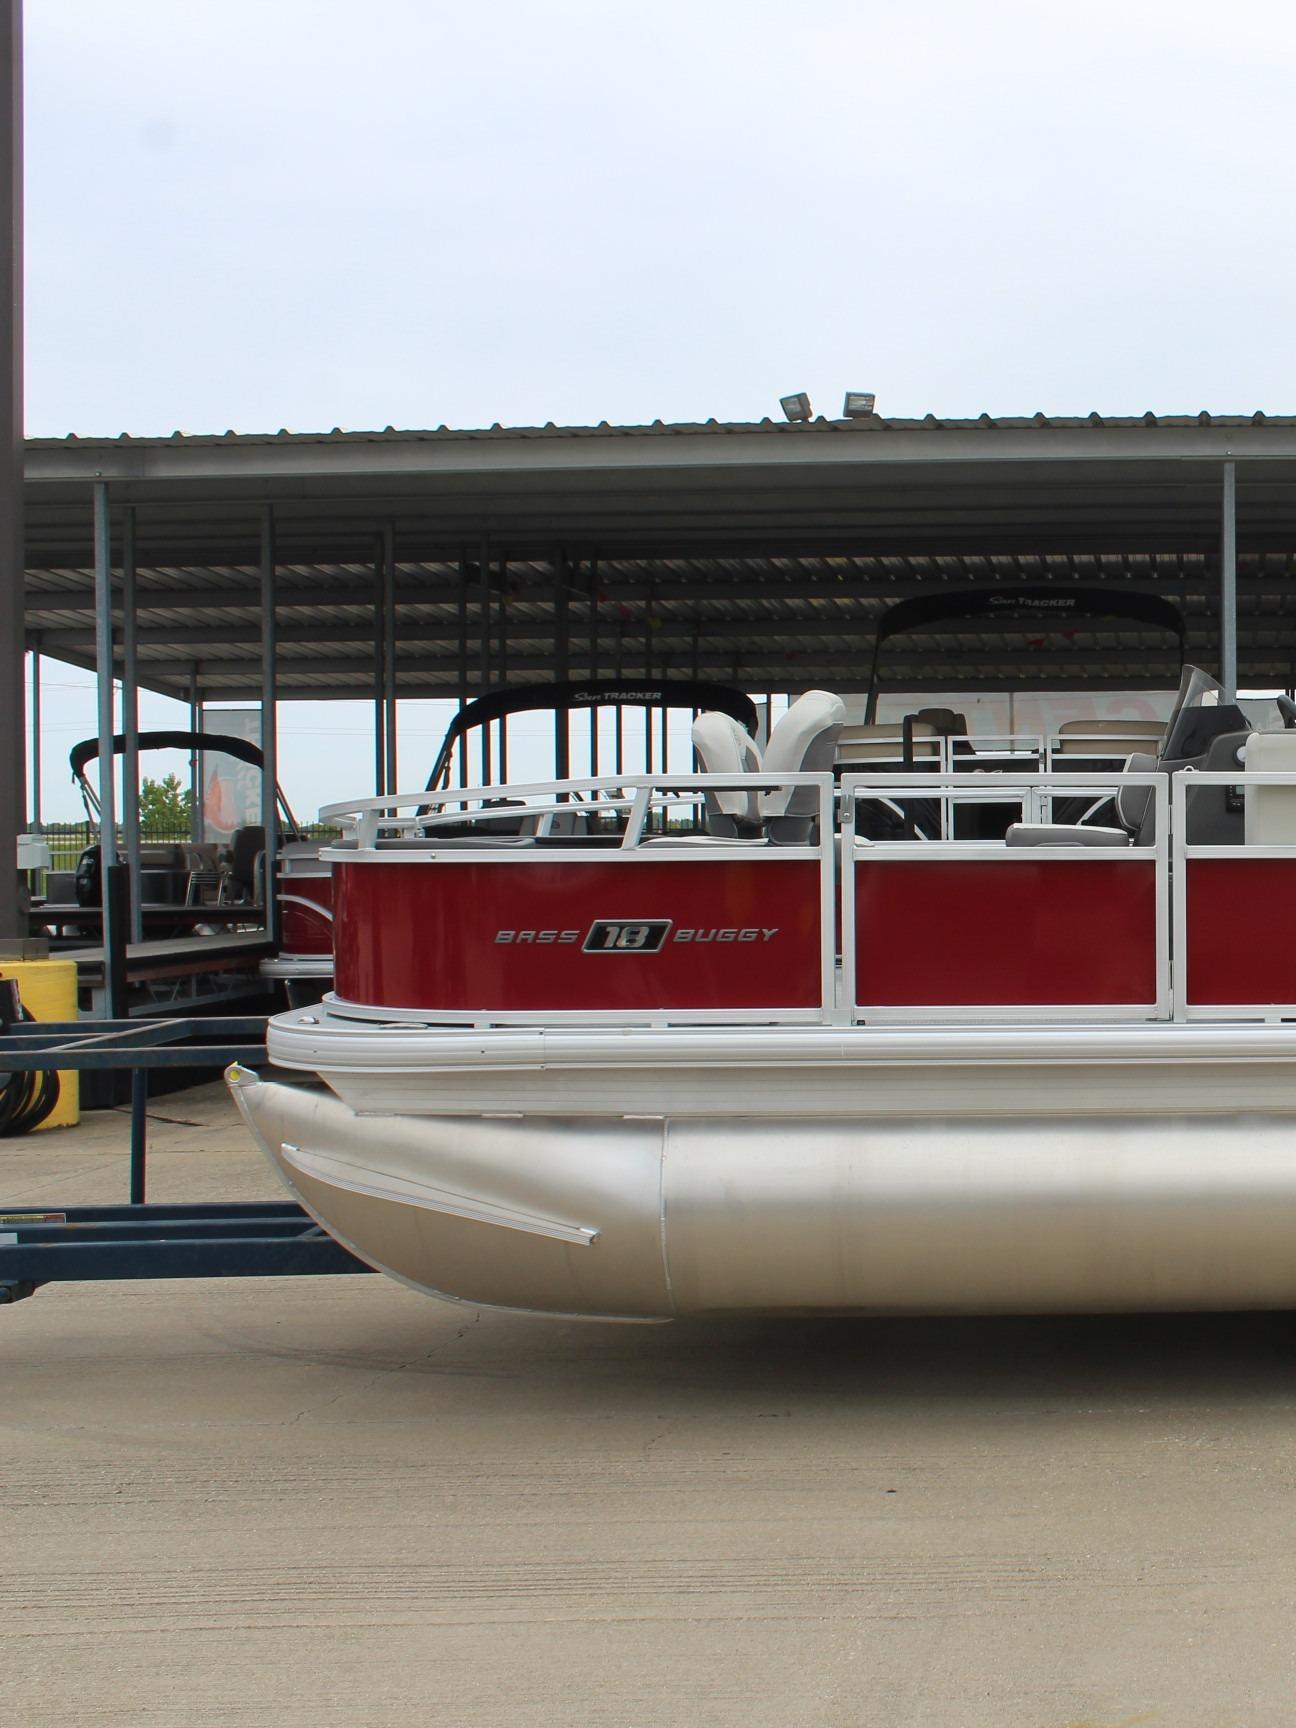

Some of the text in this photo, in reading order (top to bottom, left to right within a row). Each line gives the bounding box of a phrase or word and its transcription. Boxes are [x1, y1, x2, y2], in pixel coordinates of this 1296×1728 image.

[1018, 597, 1076, 607] TRACKER
[603, 692, 662, 700] TRACKER
[494, 926, 779, 948] BASS 18 BUGGY
